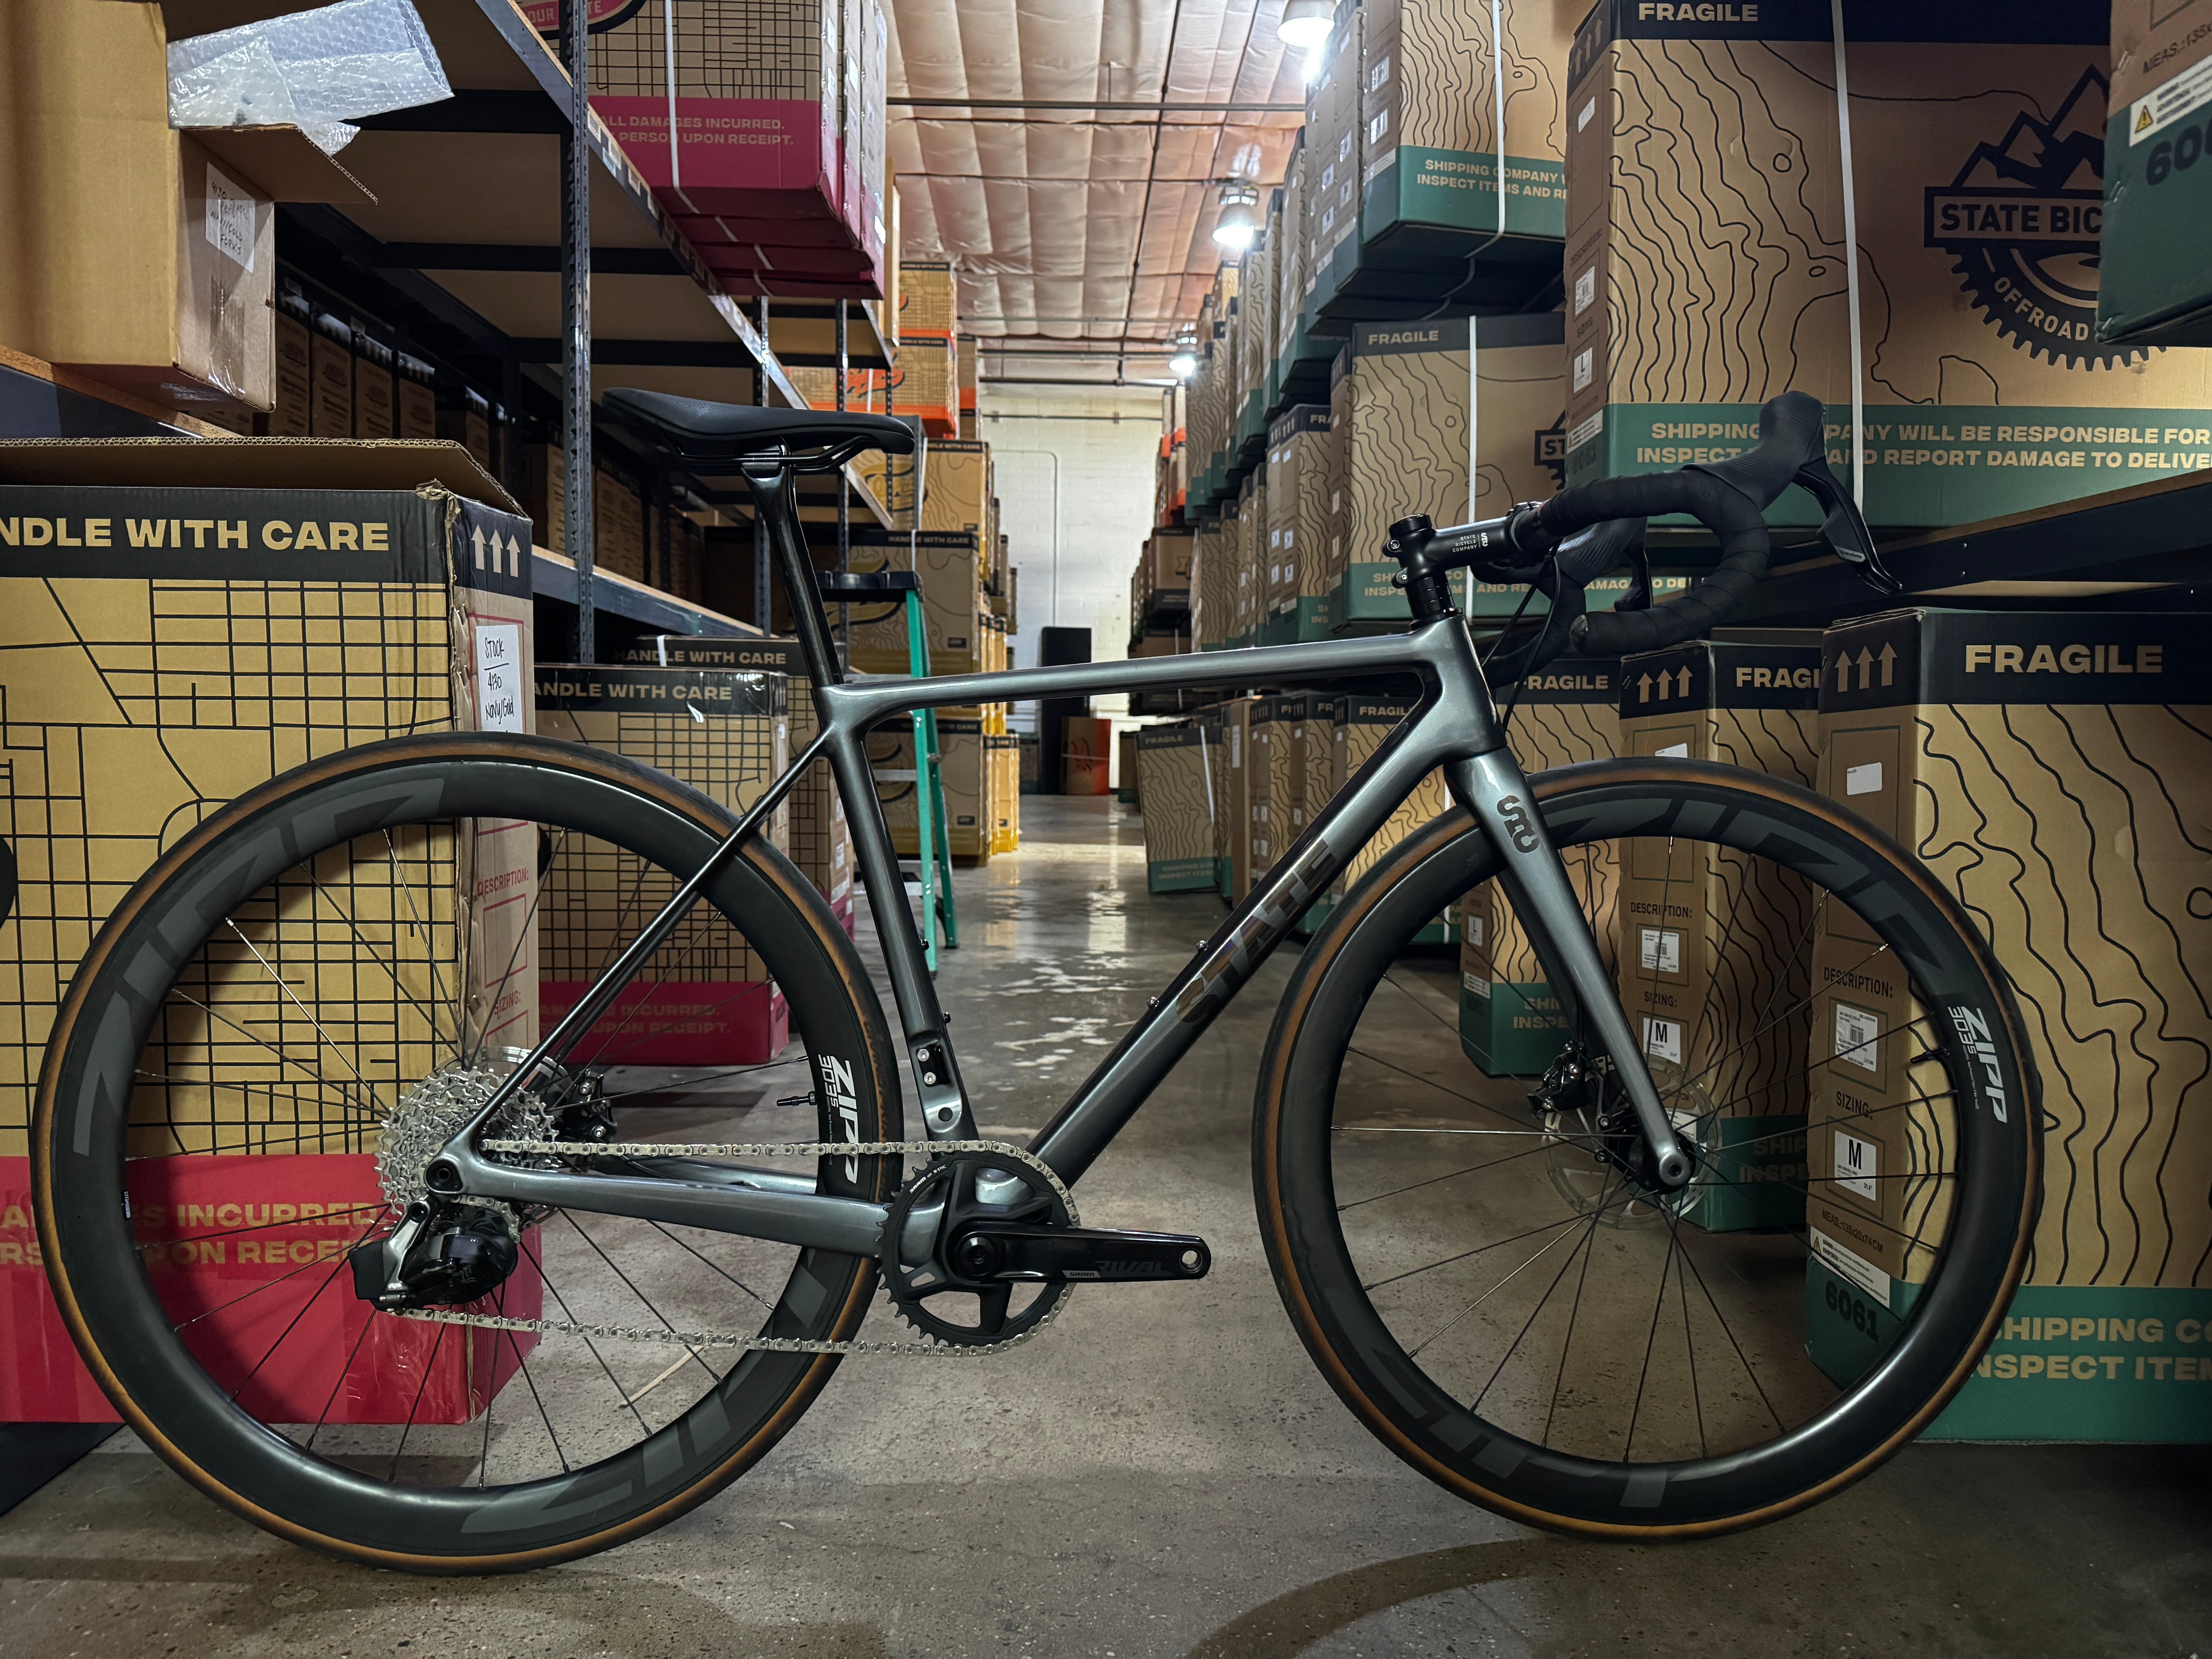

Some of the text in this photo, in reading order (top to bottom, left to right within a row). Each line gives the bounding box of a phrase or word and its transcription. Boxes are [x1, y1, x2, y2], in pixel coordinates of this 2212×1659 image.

[1639, 3, 1759, 22] FRAGILE
[706, 118, 785, 129] INCURRED.
[620, 132, 794, 146] PERSO UPON RECEIPT.
[1425, 159, 1489, 176] SHIPPING
[1417, 174, 1476, 189] INSPECT
[1523, 185, 1551, 198] AND
[1940, 203, 2040, 232] STATE
[1993, 276, 2089, 342] OFFROAD
[1368, 330, 1439, 345] FRAGILE
[1899, 425, 1955, 441] WILL
[1961, 426, 1991, 441] BE
[1997, 426, 2160, 444] RESPONSIBLE
[2164, 428, 2210, 445] FOR
[1884, 449, 1981, 466] REPORT
[1987, 450, 2085, 467] DAMAGE
[2091, 451, 2122, 468] TO
[125, 519, 248, 549] WITH
[262, 520, 389, 551] CARE
[1476, 584, 1508, 593] AND
[485, 637, 505, 659] STOCK
[689, 651, 735, 663] WITH
[738, 652, 786, 665] CARE
[1965, 644, 2164, 675] FRAGILE
[488, 672, 502, 691] 4130
[608, 684, 666, 699] WITH
[672, 685, 732, 701] CARE
[485, 694, 514, 725] Navy/Gold
[1144, 734, 1183, 745] FRAGILE
[477, 868, 529, 897] DESCRIPTION:
[1630, 902, 1693, 919] DESCRIPTION:
[1176, 837, 1337, 1024] STATE
[1824, 966, 1893, 998] DESCRIPTION:
[494, 989, 521, 1015] SIZING:
[1644, 991, 1678, 1008] SIZING:
[1655, 1022, 1667, 1043] M
[1947, 1006, 1977, 1054] 303S
[1960, 1006, 2008, 1123] ZIPP
[817, 1054, 839, 1108] 303S
[1836, 1091, 1873, 1120] SIZING:
[1848, 1139, 1862, 1170] M
[909, 1176, 926, 1194] SRAM
[1094, 1260, 1172, 1274] RIVAL
[1826, 1279, 1879, 1343] 6061
